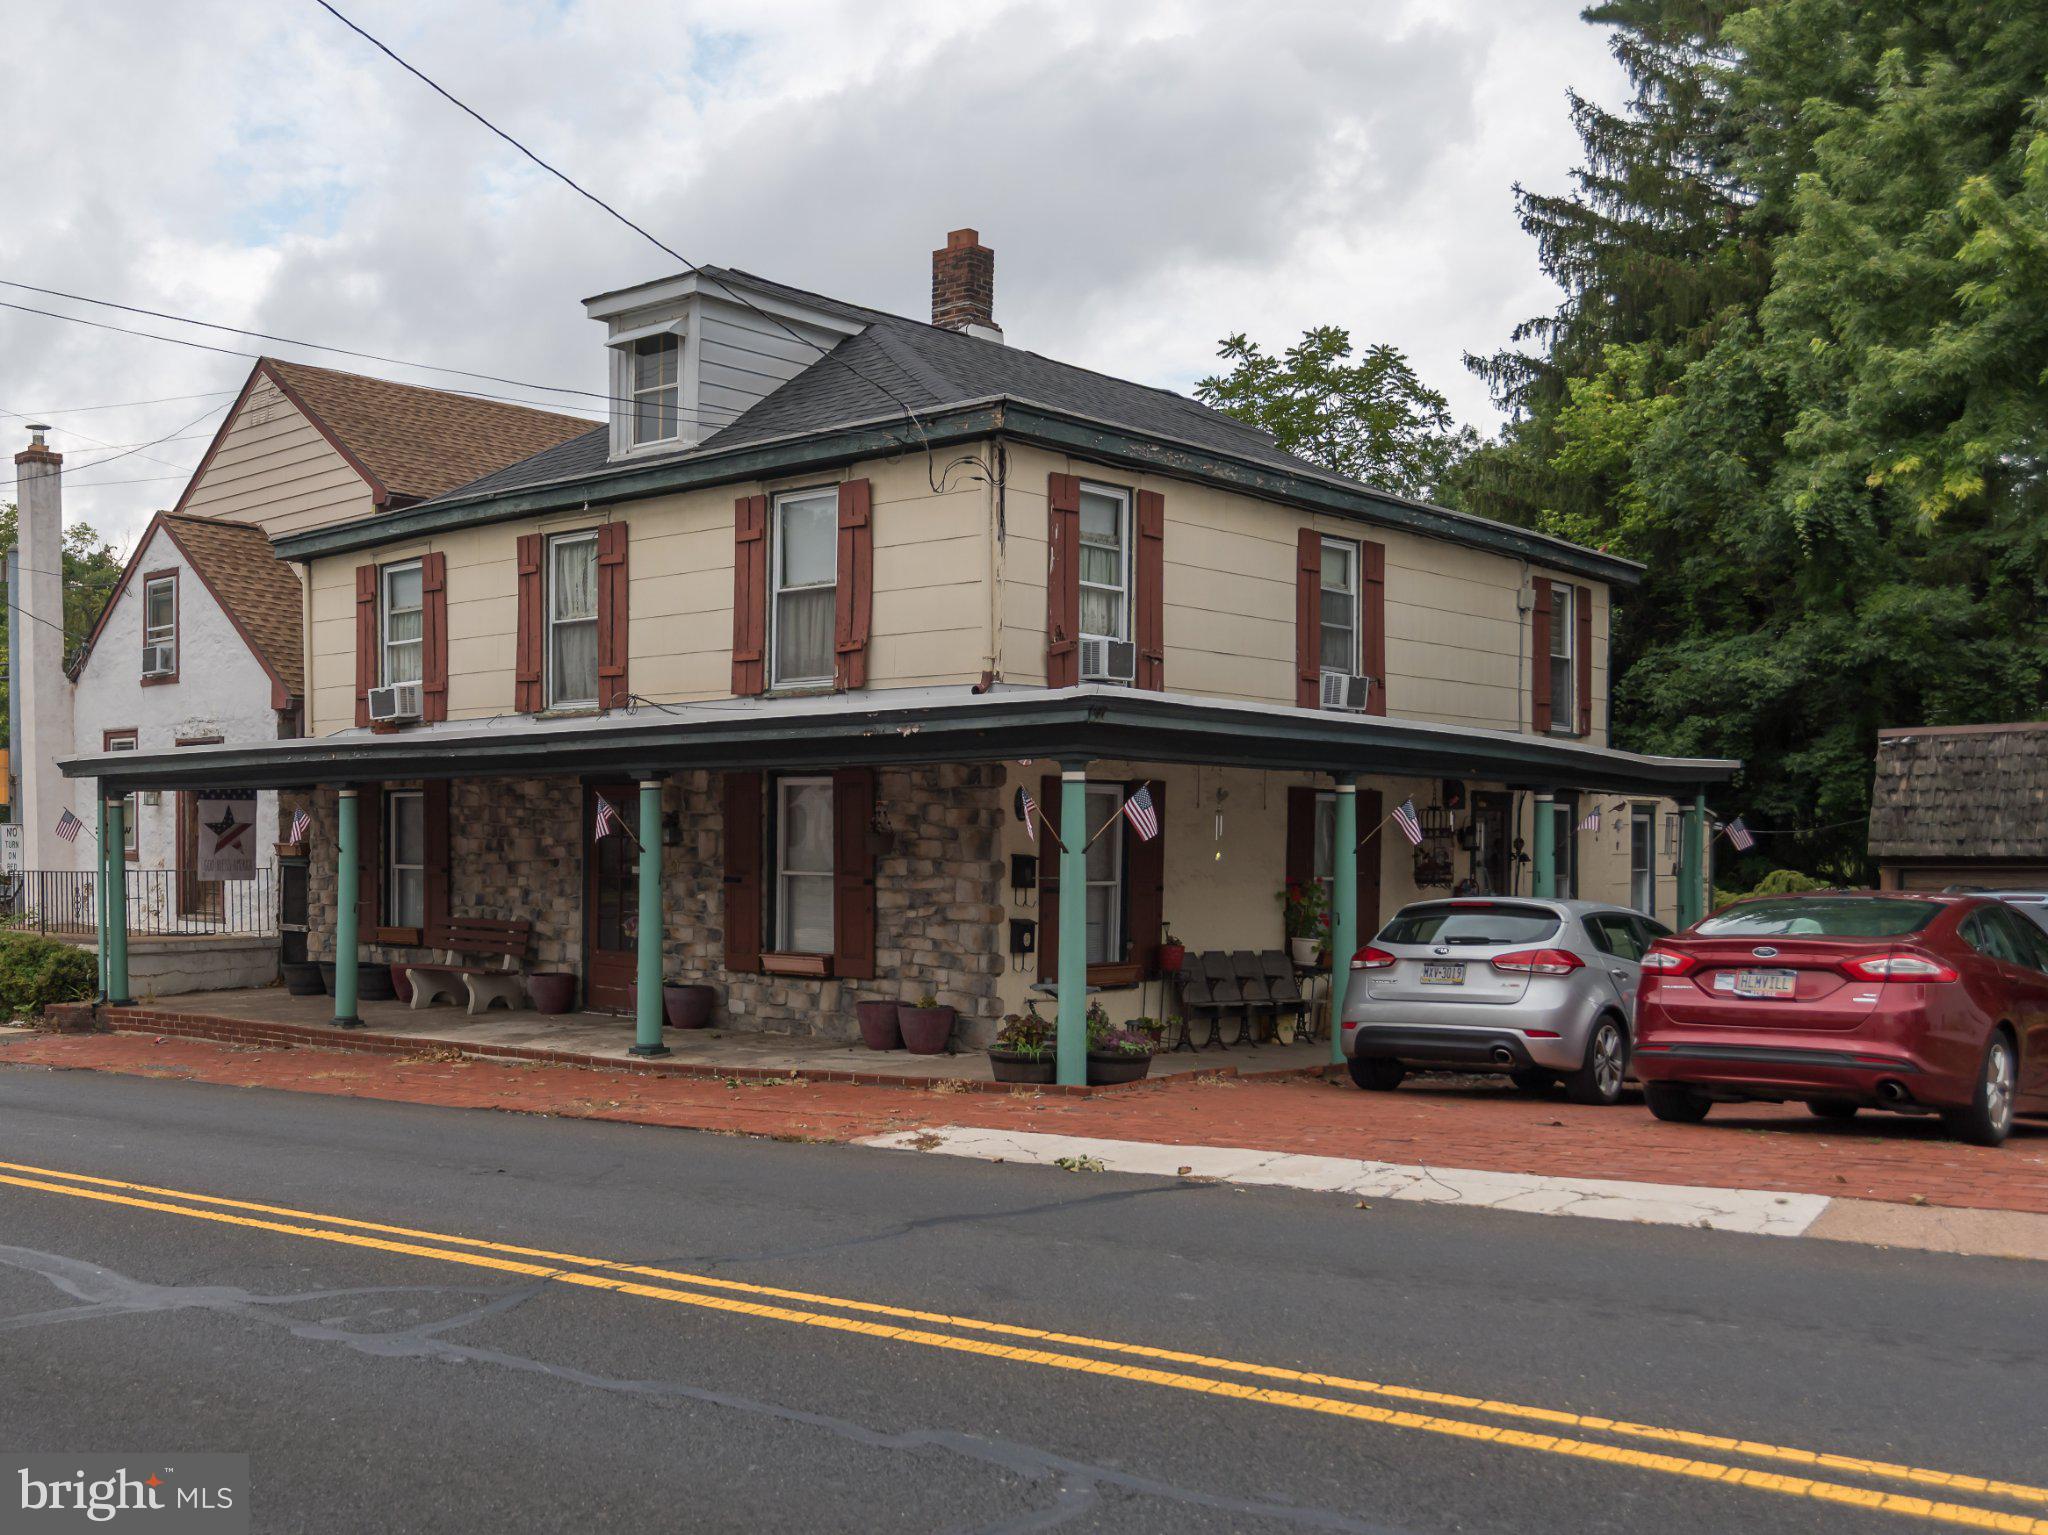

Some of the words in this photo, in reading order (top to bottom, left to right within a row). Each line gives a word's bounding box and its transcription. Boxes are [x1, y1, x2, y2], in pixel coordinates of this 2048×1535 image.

[6, 827, 18, 838] NO
[5, 840, 20, 849] TURN
[8, 851, 17, 860] ON
[1423, 966, 1462, 979] MXV-3019
[1740, 974, 1789, 990] HLMVILL
